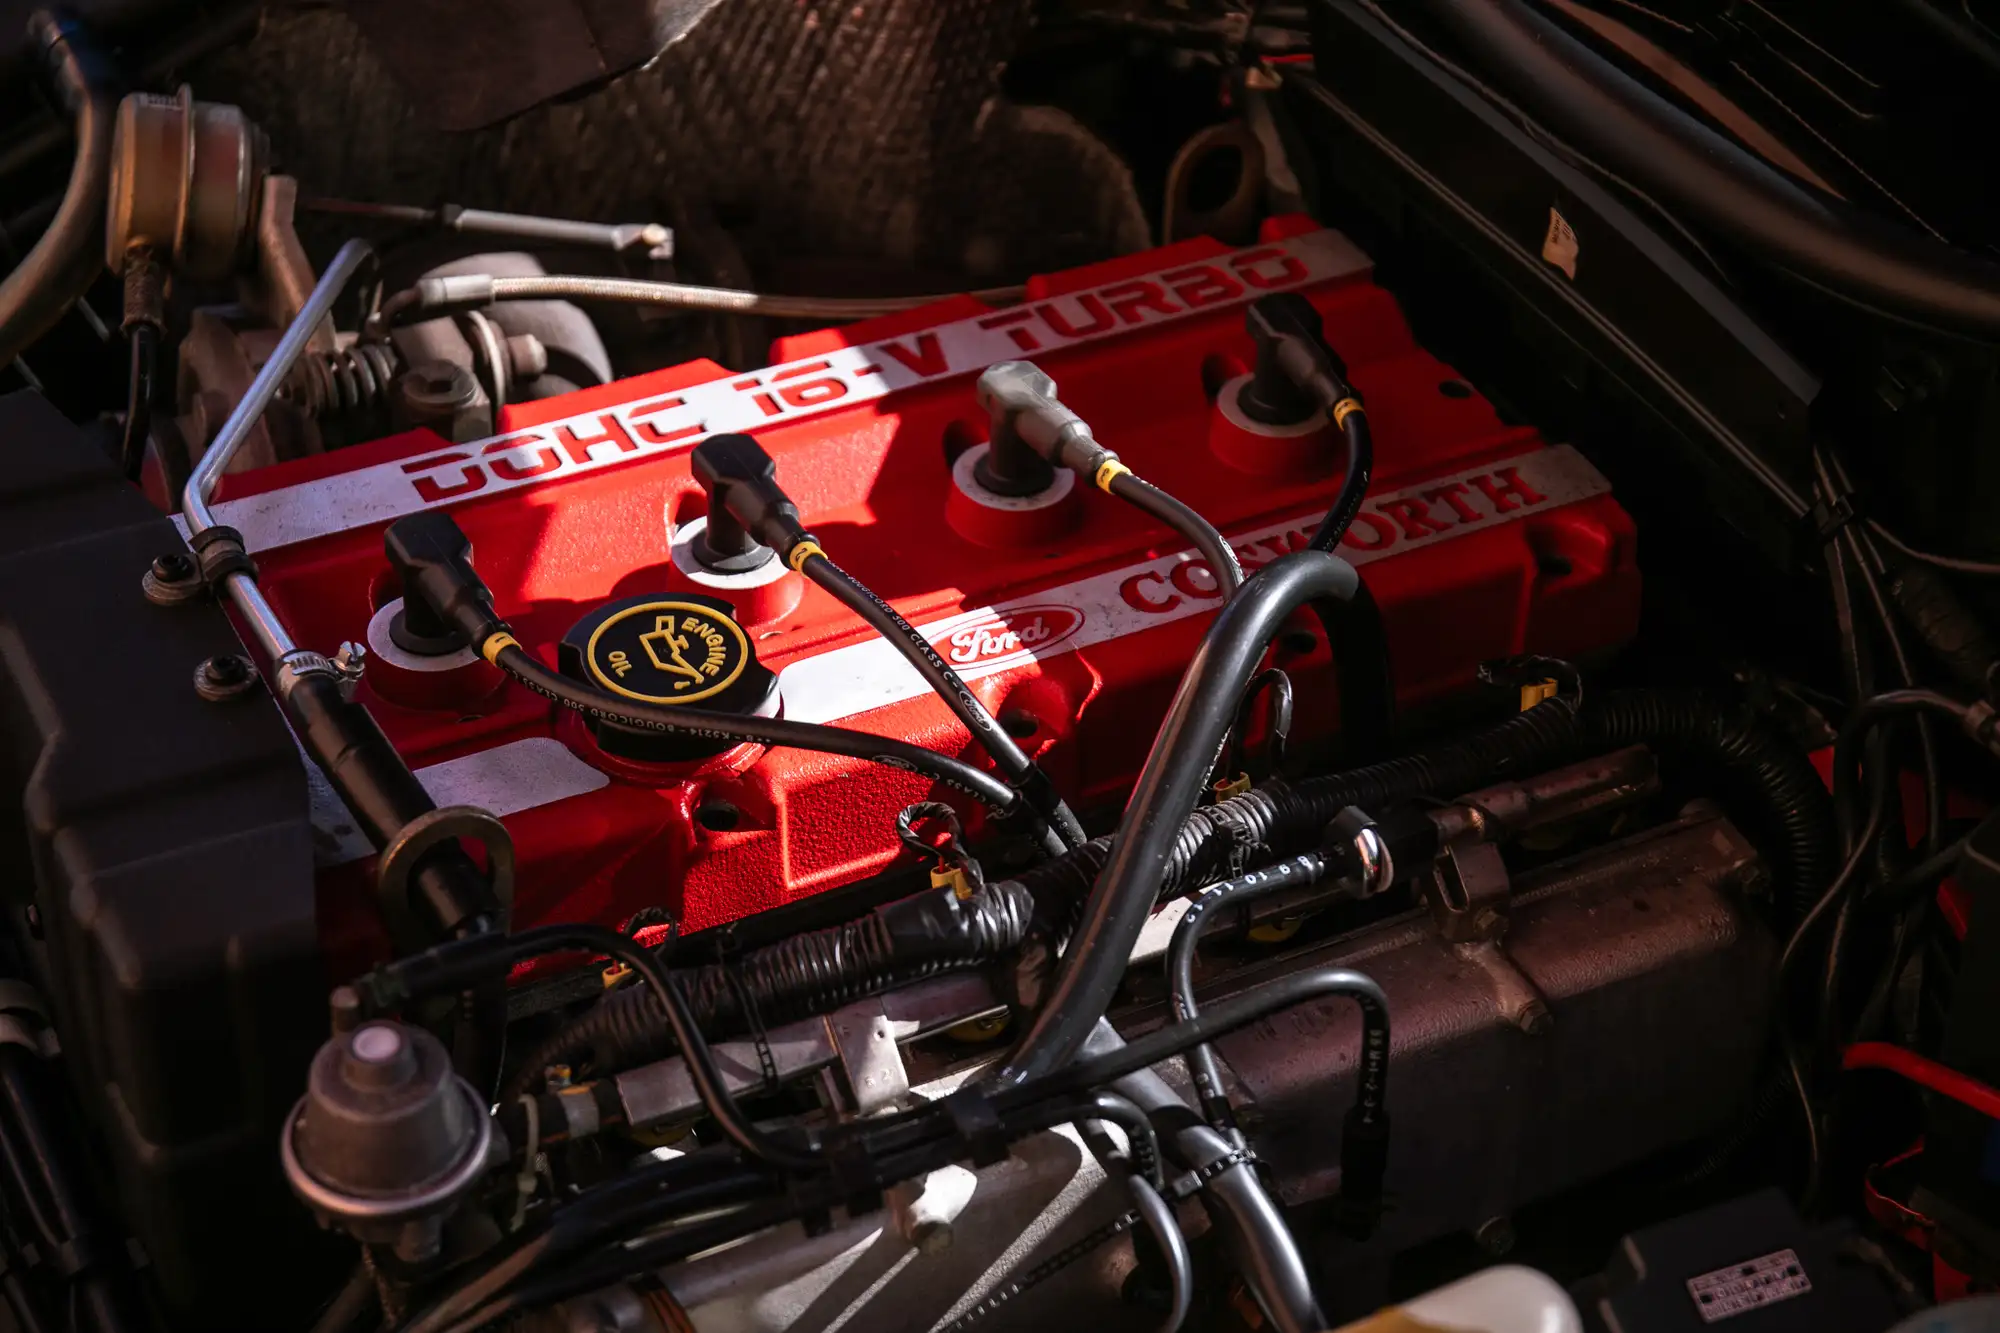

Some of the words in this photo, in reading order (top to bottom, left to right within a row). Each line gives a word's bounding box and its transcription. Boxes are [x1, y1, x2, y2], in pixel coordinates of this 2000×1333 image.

[401, 397, 706, 503] DOHC
[732, 331, 949, 418] 16-V
[978, 247, 1310, 351] TURBO
[681, 616, 727, 677] ENGINE
[891, 615, 910, 632] 500
[909, 631, 944, 668] CLASS
[949, 614, 1050, 664] Ford
[608, 650, 633, 679] OIL
[564, 698, 585, 713] 500
[590, 707, 675, 734] BOUGICORD
